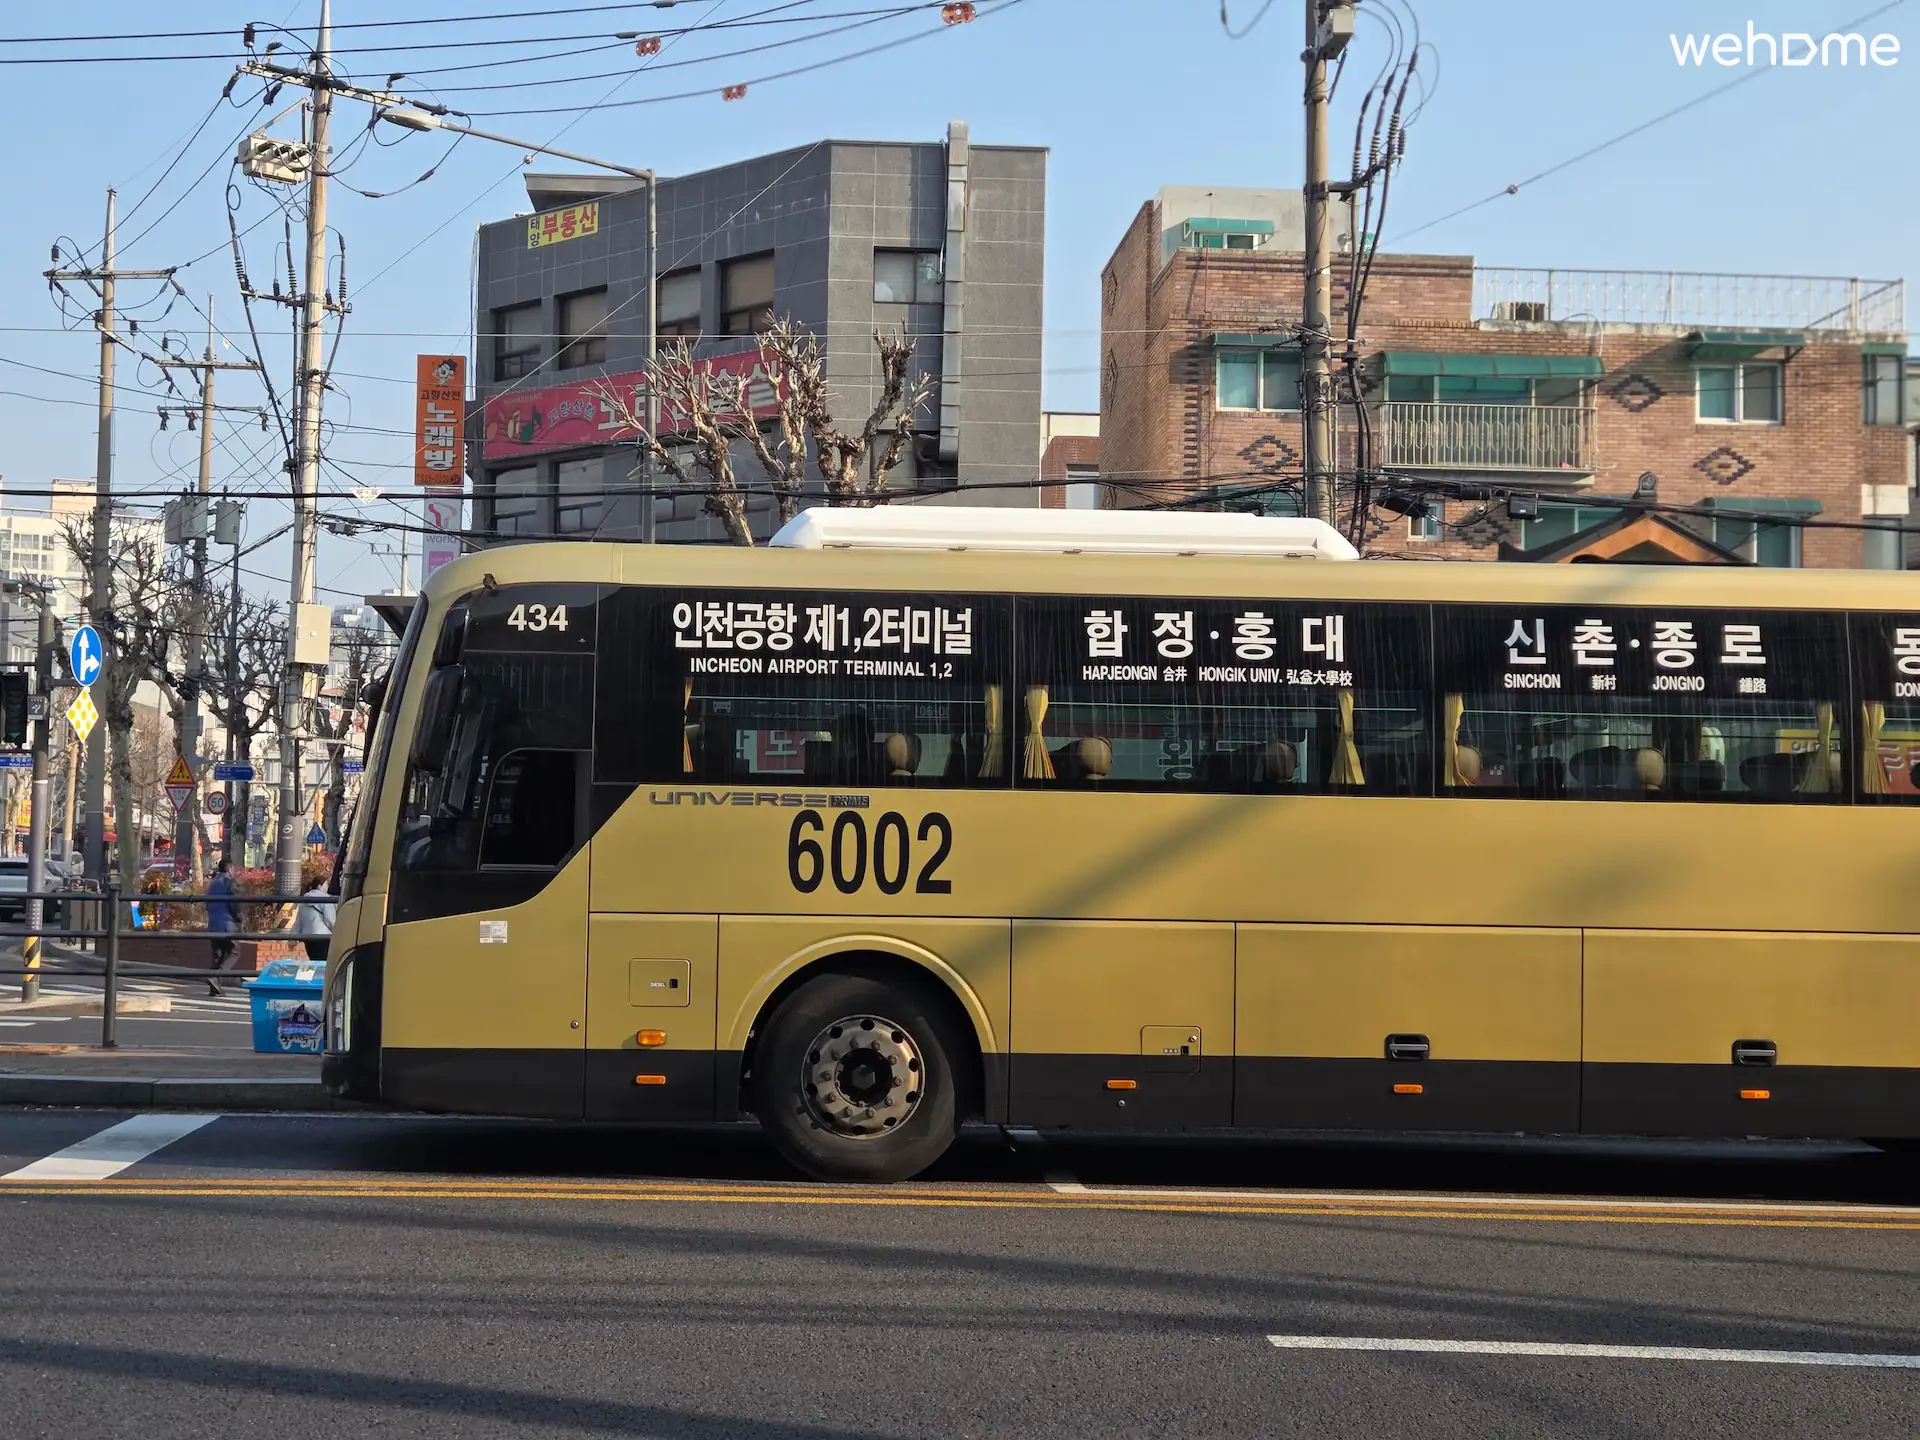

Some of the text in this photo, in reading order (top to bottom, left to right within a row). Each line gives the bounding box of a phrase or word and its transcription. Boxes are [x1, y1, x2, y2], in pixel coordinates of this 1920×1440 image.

[530, 215, 540, 247] 태양
[542, 204, 597, 242] 부동산
[423, 402, 457, 471] 노래방
[507, 603, 569, 632] 434
[672, 601, 973, 655] 인천공항 제1,2터미널
[690, 657, 953, 679] INCHEON AIRPORT TERMINAL 1,2
[1082, 665, 1158, 682] HAPJEONGN
[1163, 666, 1188, 682] 合井
[1199, 666, 1283, 684] HONGIK UNIV.
[1503, 673, 1561, 689] SINCHON
[1591, 674, 1617, 691] 新村
[1652, 675, 1705, 692] JONGNO
[211, 797, 224, 808] 50
[650, 791, 868, 807] UNIVERSE PRIME
[788, 809, 953, 895] 6002
